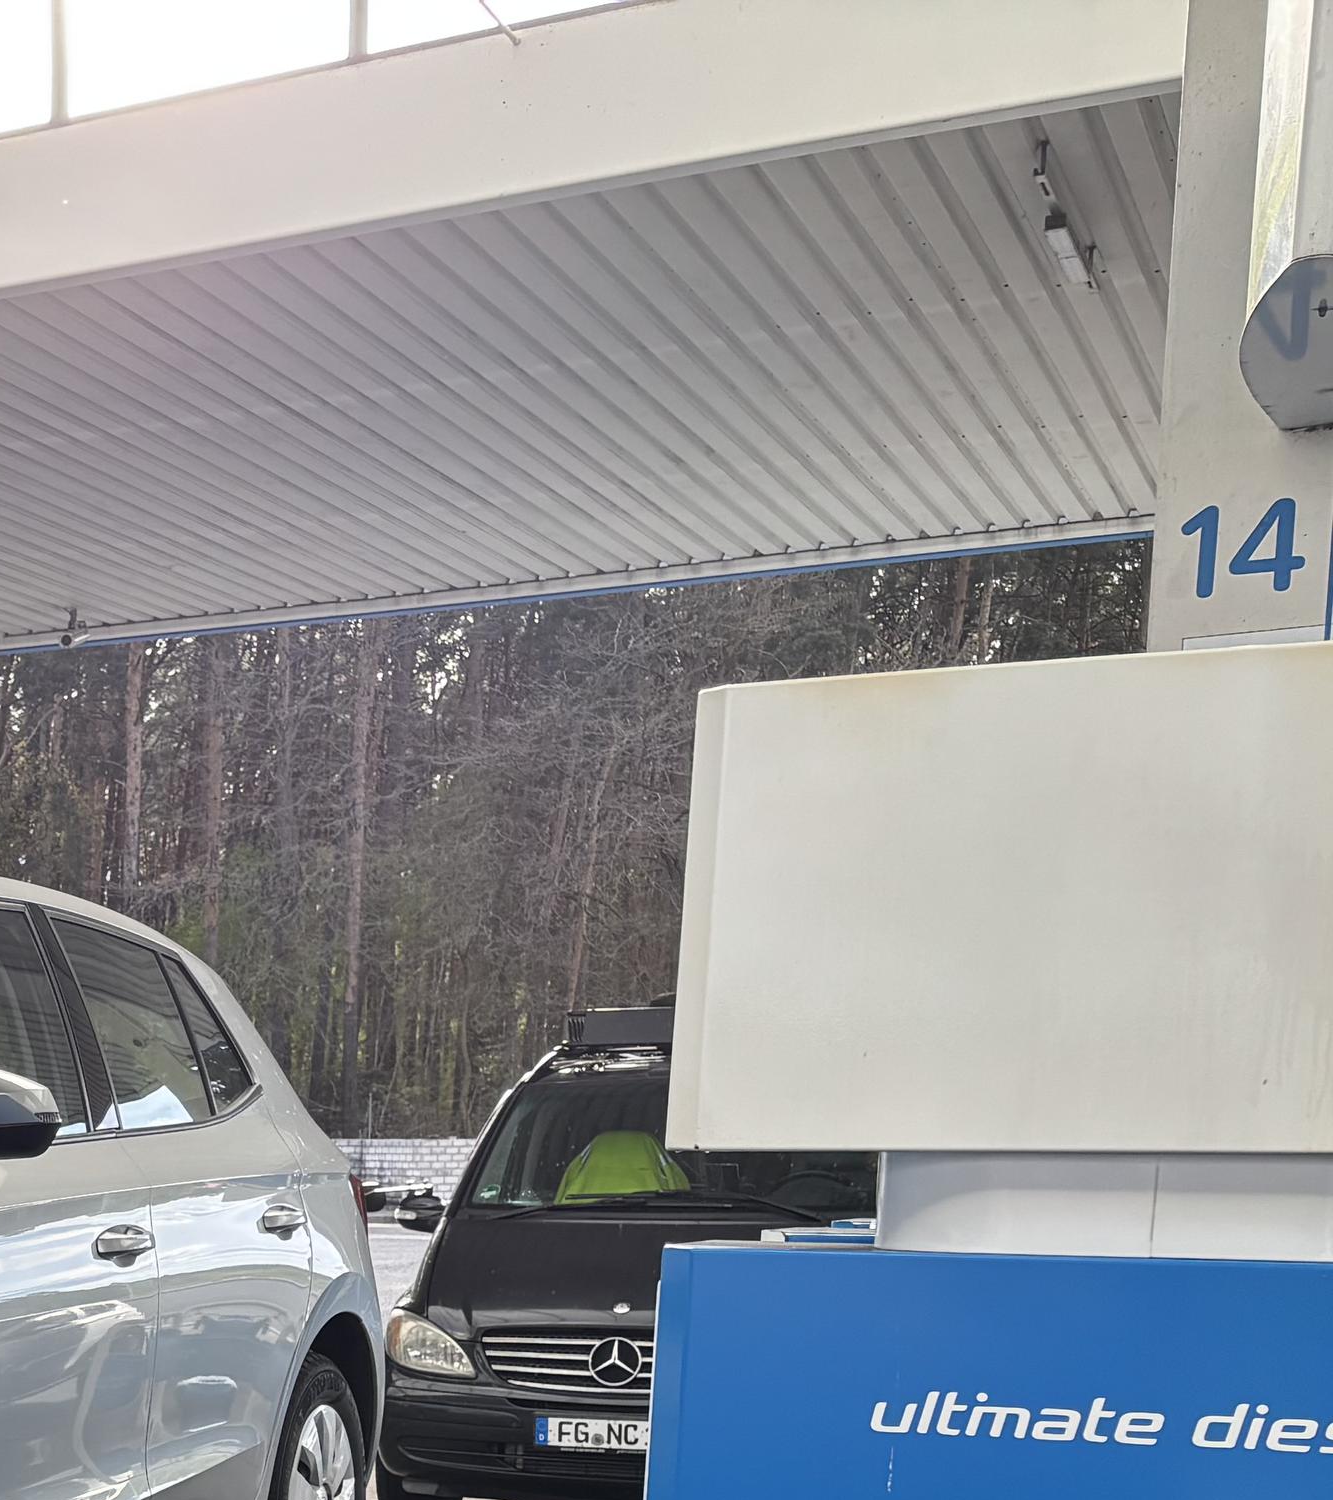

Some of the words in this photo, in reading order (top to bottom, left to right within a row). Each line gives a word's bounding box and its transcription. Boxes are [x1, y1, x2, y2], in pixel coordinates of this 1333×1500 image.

[1181, 498, 1305, 598] 14
[557, 1421, 590, 1443] FG
[870, 1390, 1164, 1446] ultimate
[1191, 1403, 1333, 1454] die
